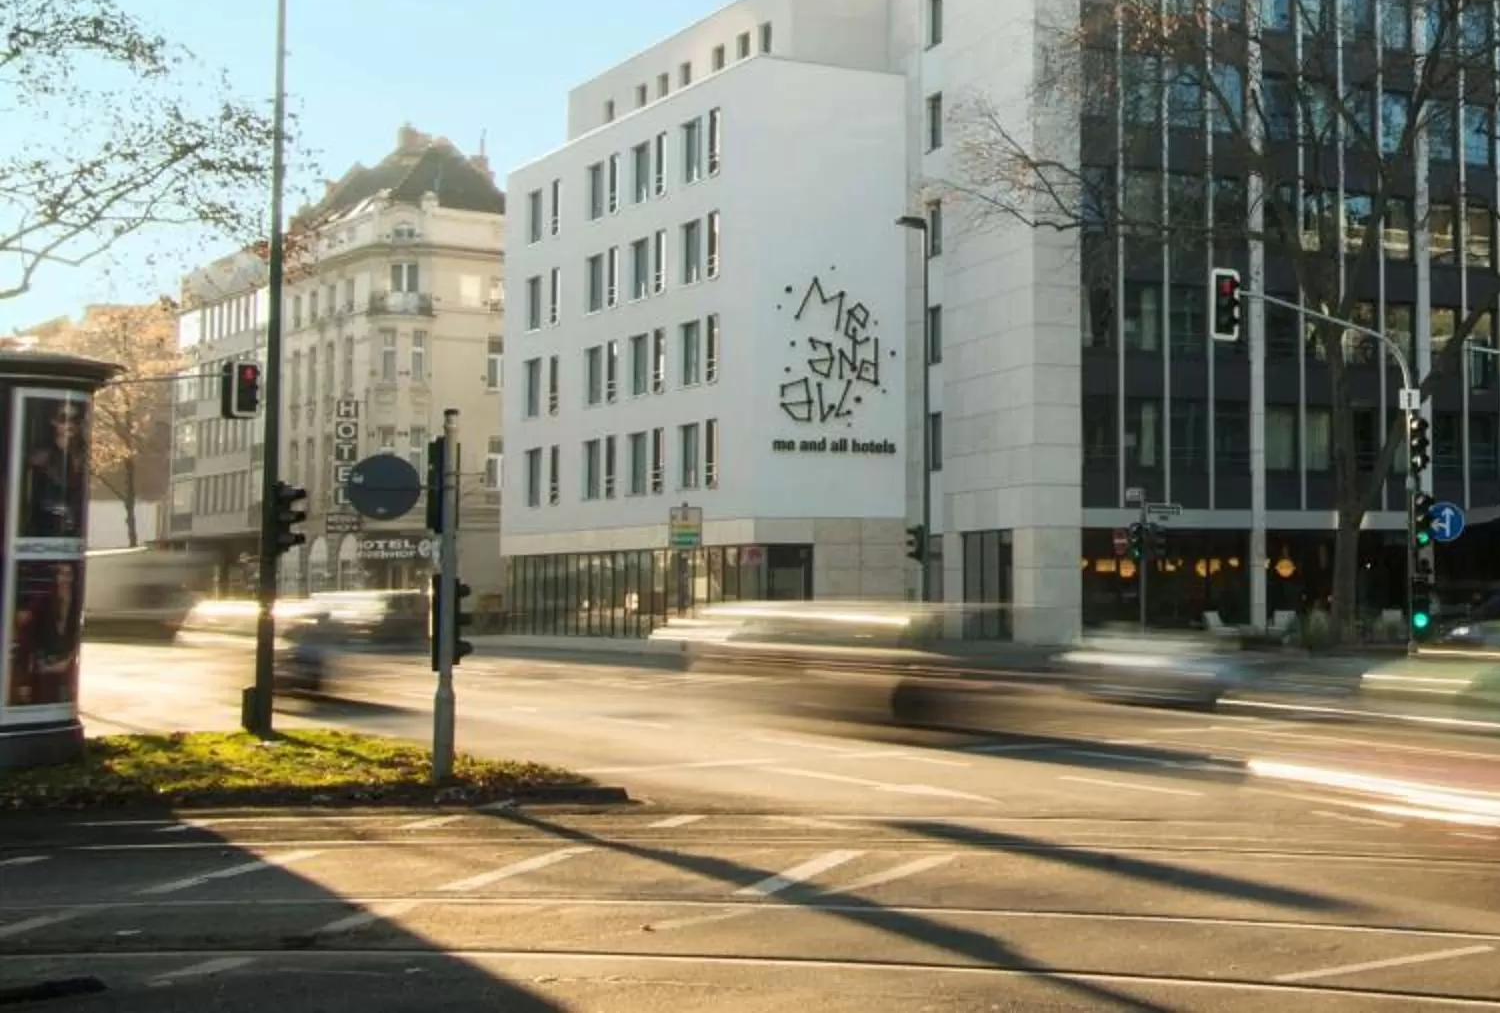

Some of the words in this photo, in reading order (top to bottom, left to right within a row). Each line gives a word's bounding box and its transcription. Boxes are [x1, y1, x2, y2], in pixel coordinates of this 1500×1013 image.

[338, 402, 356, 504] HOTEL
[772, 439, 796, 452] me
[799, 437, 827, 453] and
[830, 437, 848, 453] all
[852, 438, 897, 455] hotels
